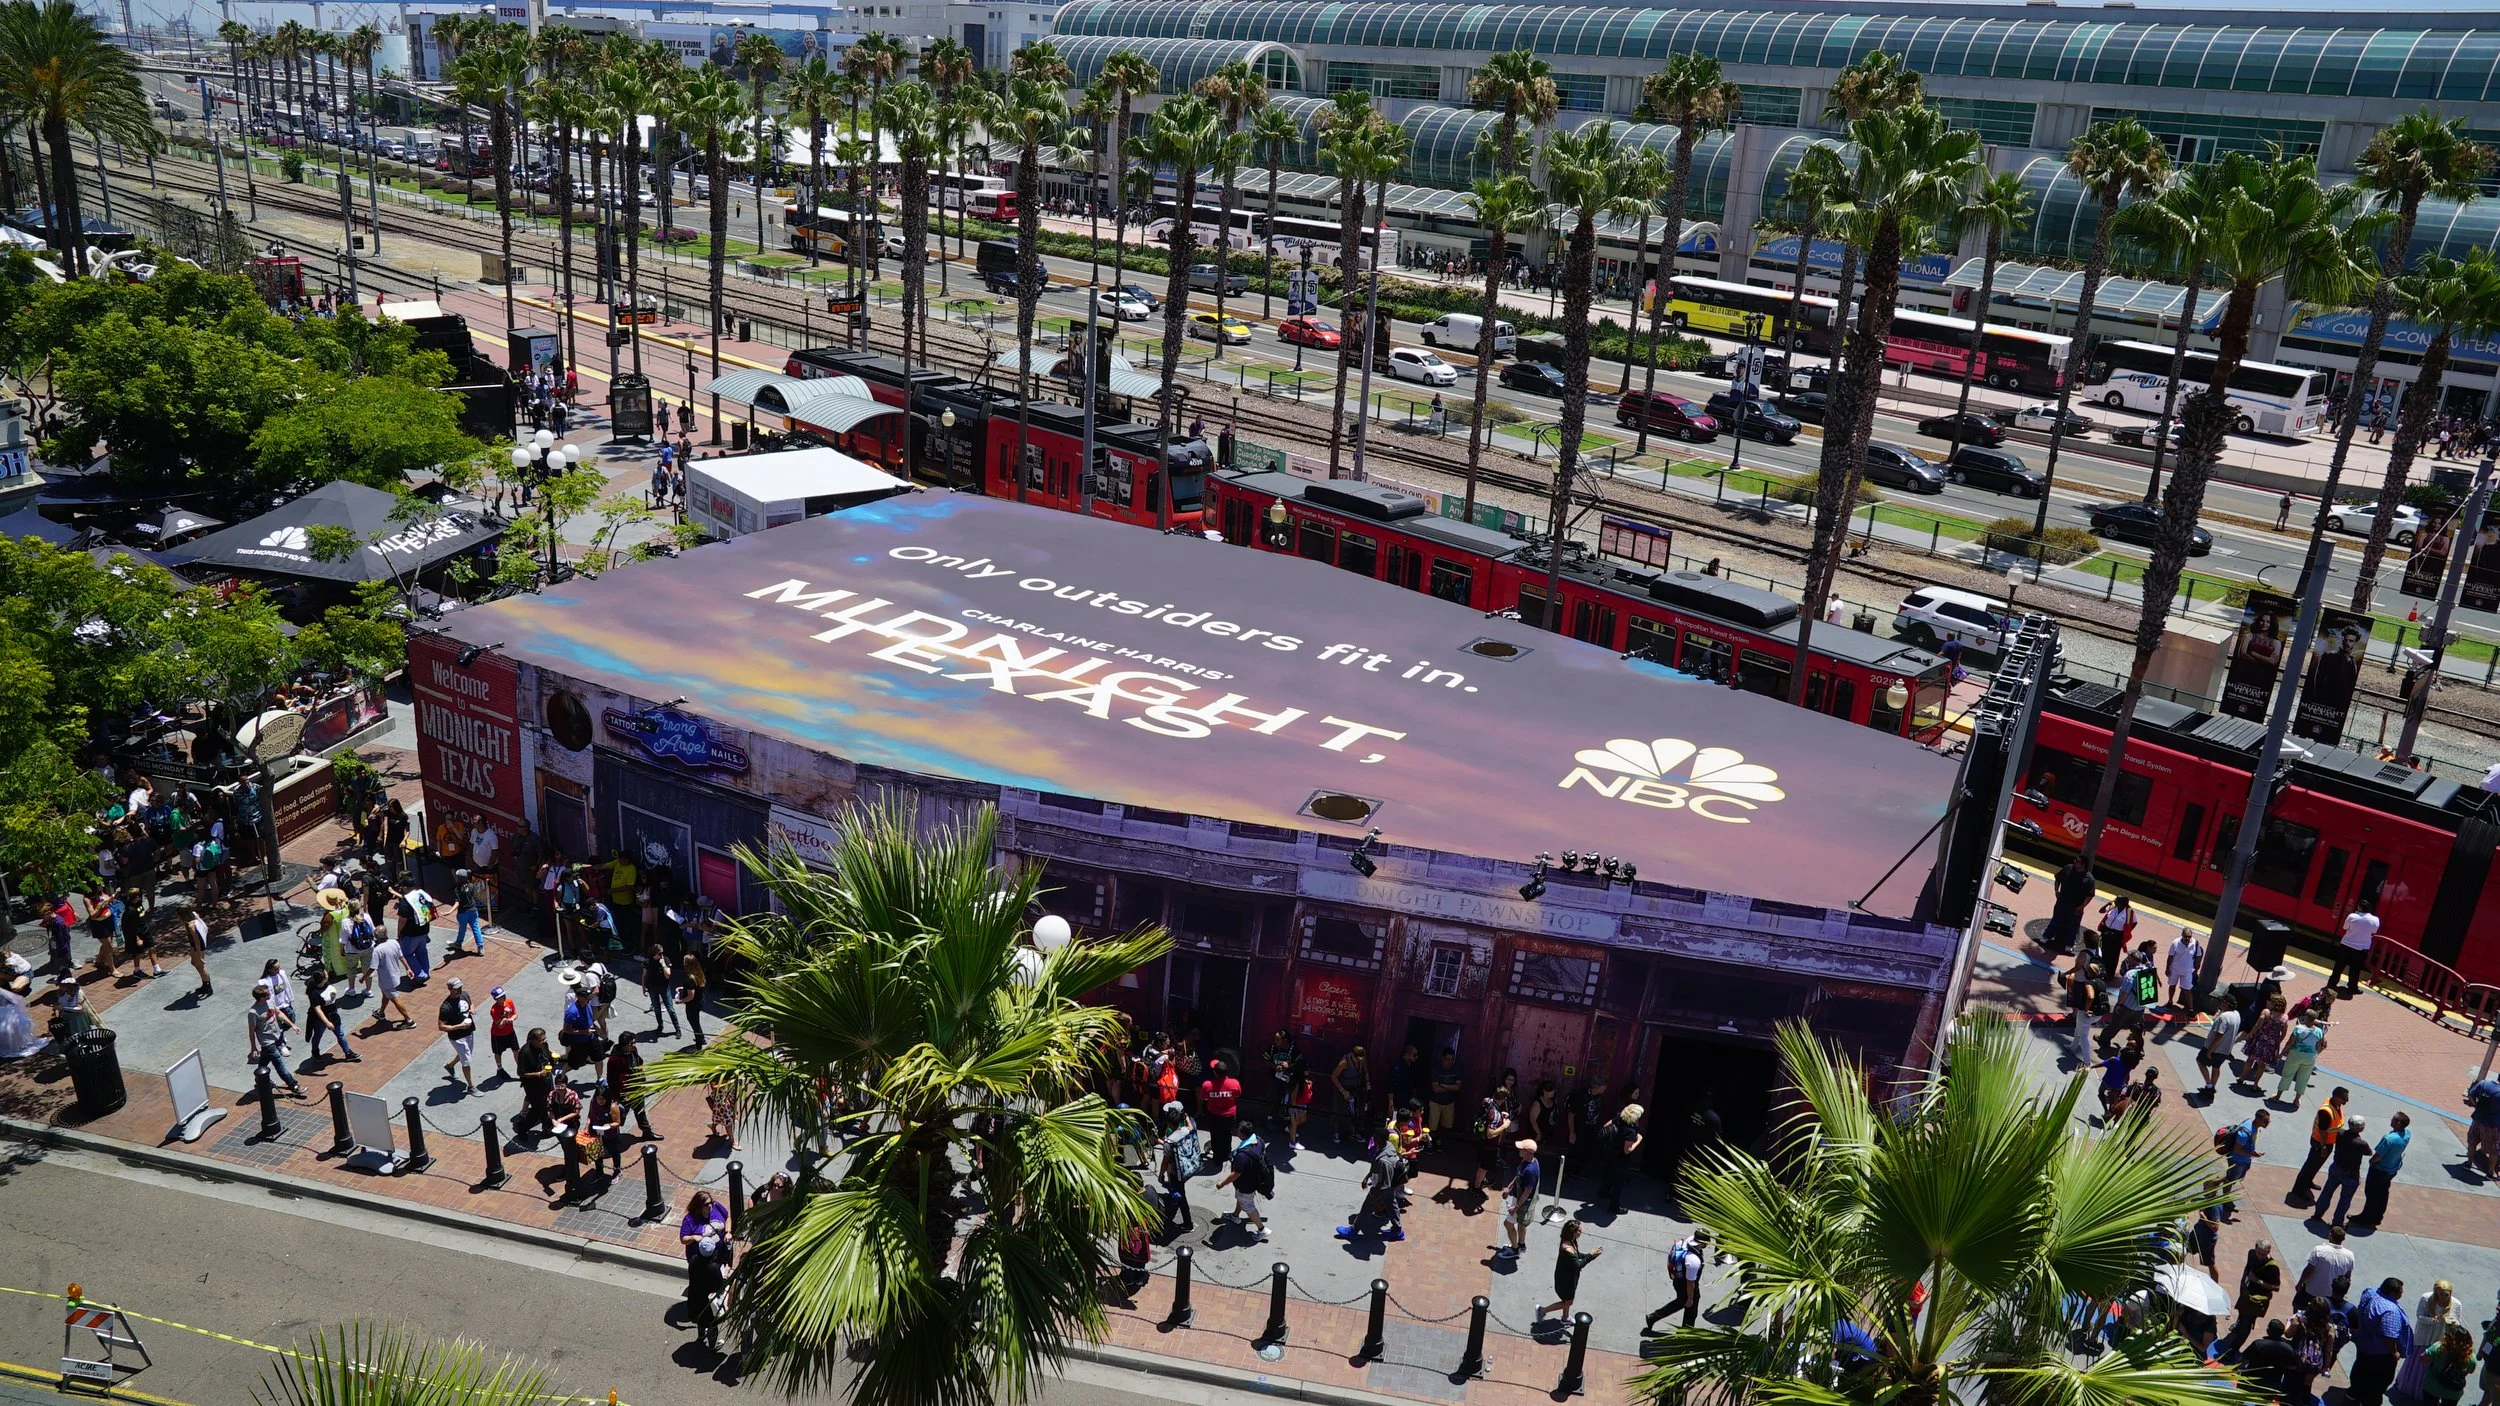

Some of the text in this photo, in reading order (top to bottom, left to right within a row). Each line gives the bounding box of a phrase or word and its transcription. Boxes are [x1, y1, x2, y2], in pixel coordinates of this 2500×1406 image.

[499, 8, 526, 17] TESTED
[664, 40, 676, 48] NOT
[677, 40, 681, 48] A
[685, 49, 705, 57] X-GENE
[1236, 448, 1262, 461] Cuando
[1293, 507, 1346, 526] Metropolitan Transit System
[399, 525, 461, 555] TEXAS
[236, 548, 254, 556] THIS
[254, 549, 289, 560] MONDAY
[889, 546, 1480, 692] Only outsiders fit in.
[1675, 618, 1750, 644] Metropolitan Transit System
[961, 609, 1236, 681] CHARLAINE HARRIS'
[432, 659, 490, 701] Welcome
[743, 579, 1406, 763] MIDNIGHT,
[810, 616, 1228, 740] TEXAS
[1870, 674, 1895, 686] 2029
[457, 697, 466, 711] to
[262, 716, 294, 740] HOME
[420, 700, 511, 766] MIDNIGHT
[654, 734, 707, 755] Angel
[134, 761, 185, 773] THIS MONDAY
[436, 745, 495, 799] TEXAS
[2124, 753, 2146, 765] Transit
[2146, 760, 2172, 774] System
[283, 800, 299, 814] food.
[300, 789, 315, 803] Good
[315, 782, 334, 796] times.
[1558, 767, 1759, 823] NBC
[275, 811, 299, 827] Strange
[300, 794, 328, 814] company.
[2106, 824, 2163, 847] San Diego Trolley
[1325, 883, 1592, 931] MIDNIGHT PAWNSHOP
[1319, 981, 1350, 997] Open
[1302, 1004, 1311, 1012] 24
[1312, 1006, 1336, 1016] HOURS
[1313, 997, 1329, 1006] DAYS
[1338, 1003, 1357, 1011] WEEK
[74, 1362, 97, 1371] ACME
